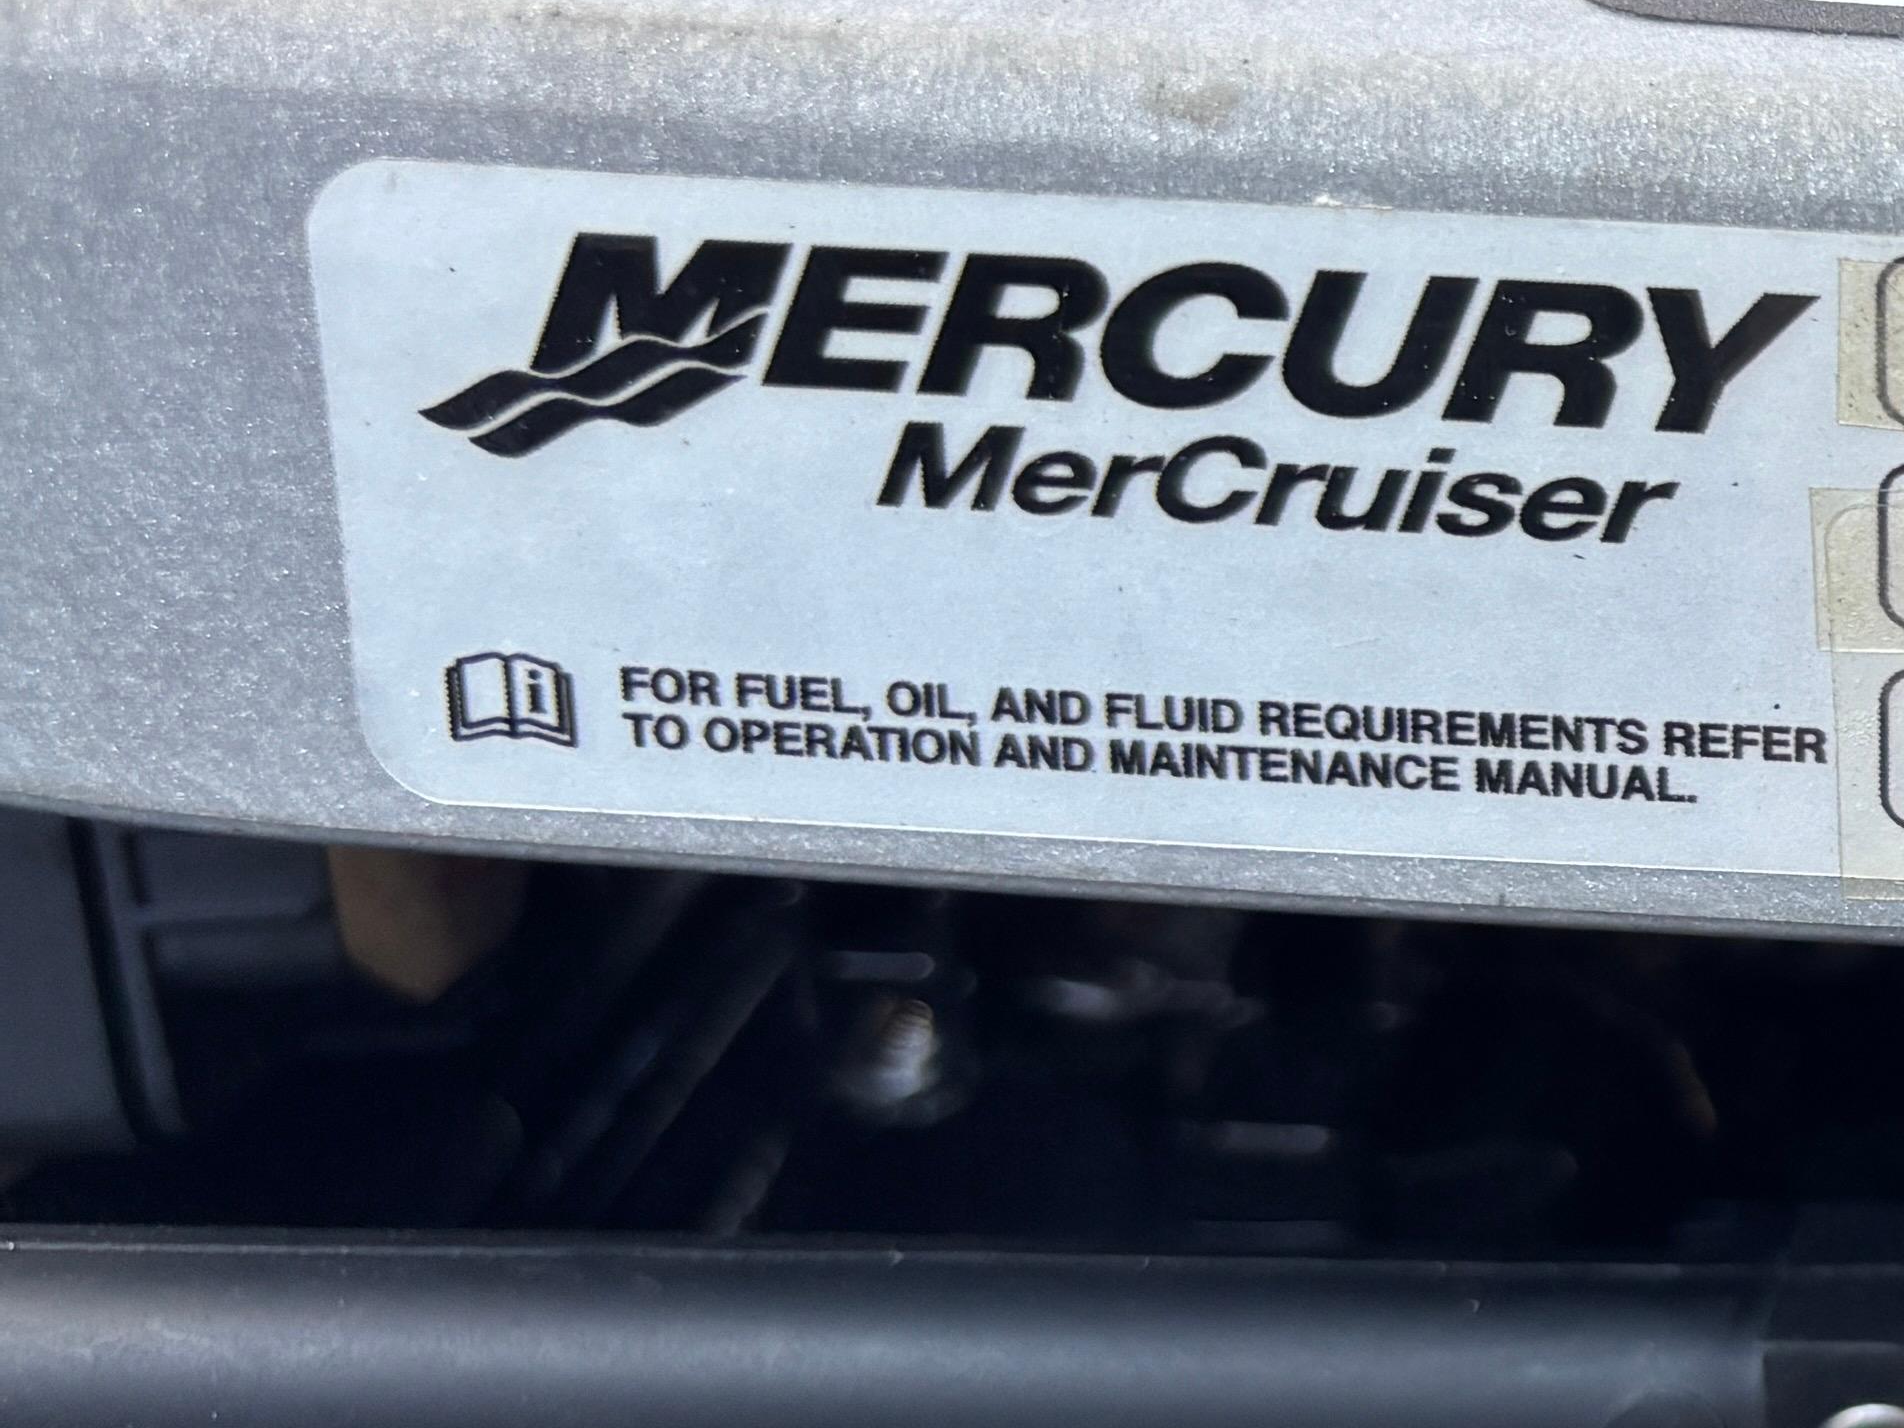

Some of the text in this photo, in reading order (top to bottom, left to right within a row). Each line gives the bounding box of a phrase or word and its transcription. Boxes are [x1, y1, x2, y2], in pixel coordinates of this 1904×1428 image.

[530, 231, 1821, 435] MERCURY
[876, 422, 1681, 543] MerCruiser
[619, 665, 1828, 764] FOR FUEL, OIL, AND FLUID REQUIREMENTS REFER
[623, 712, 1698, 804] TO OPERATION AND MAINTENANCE MANUAL.
